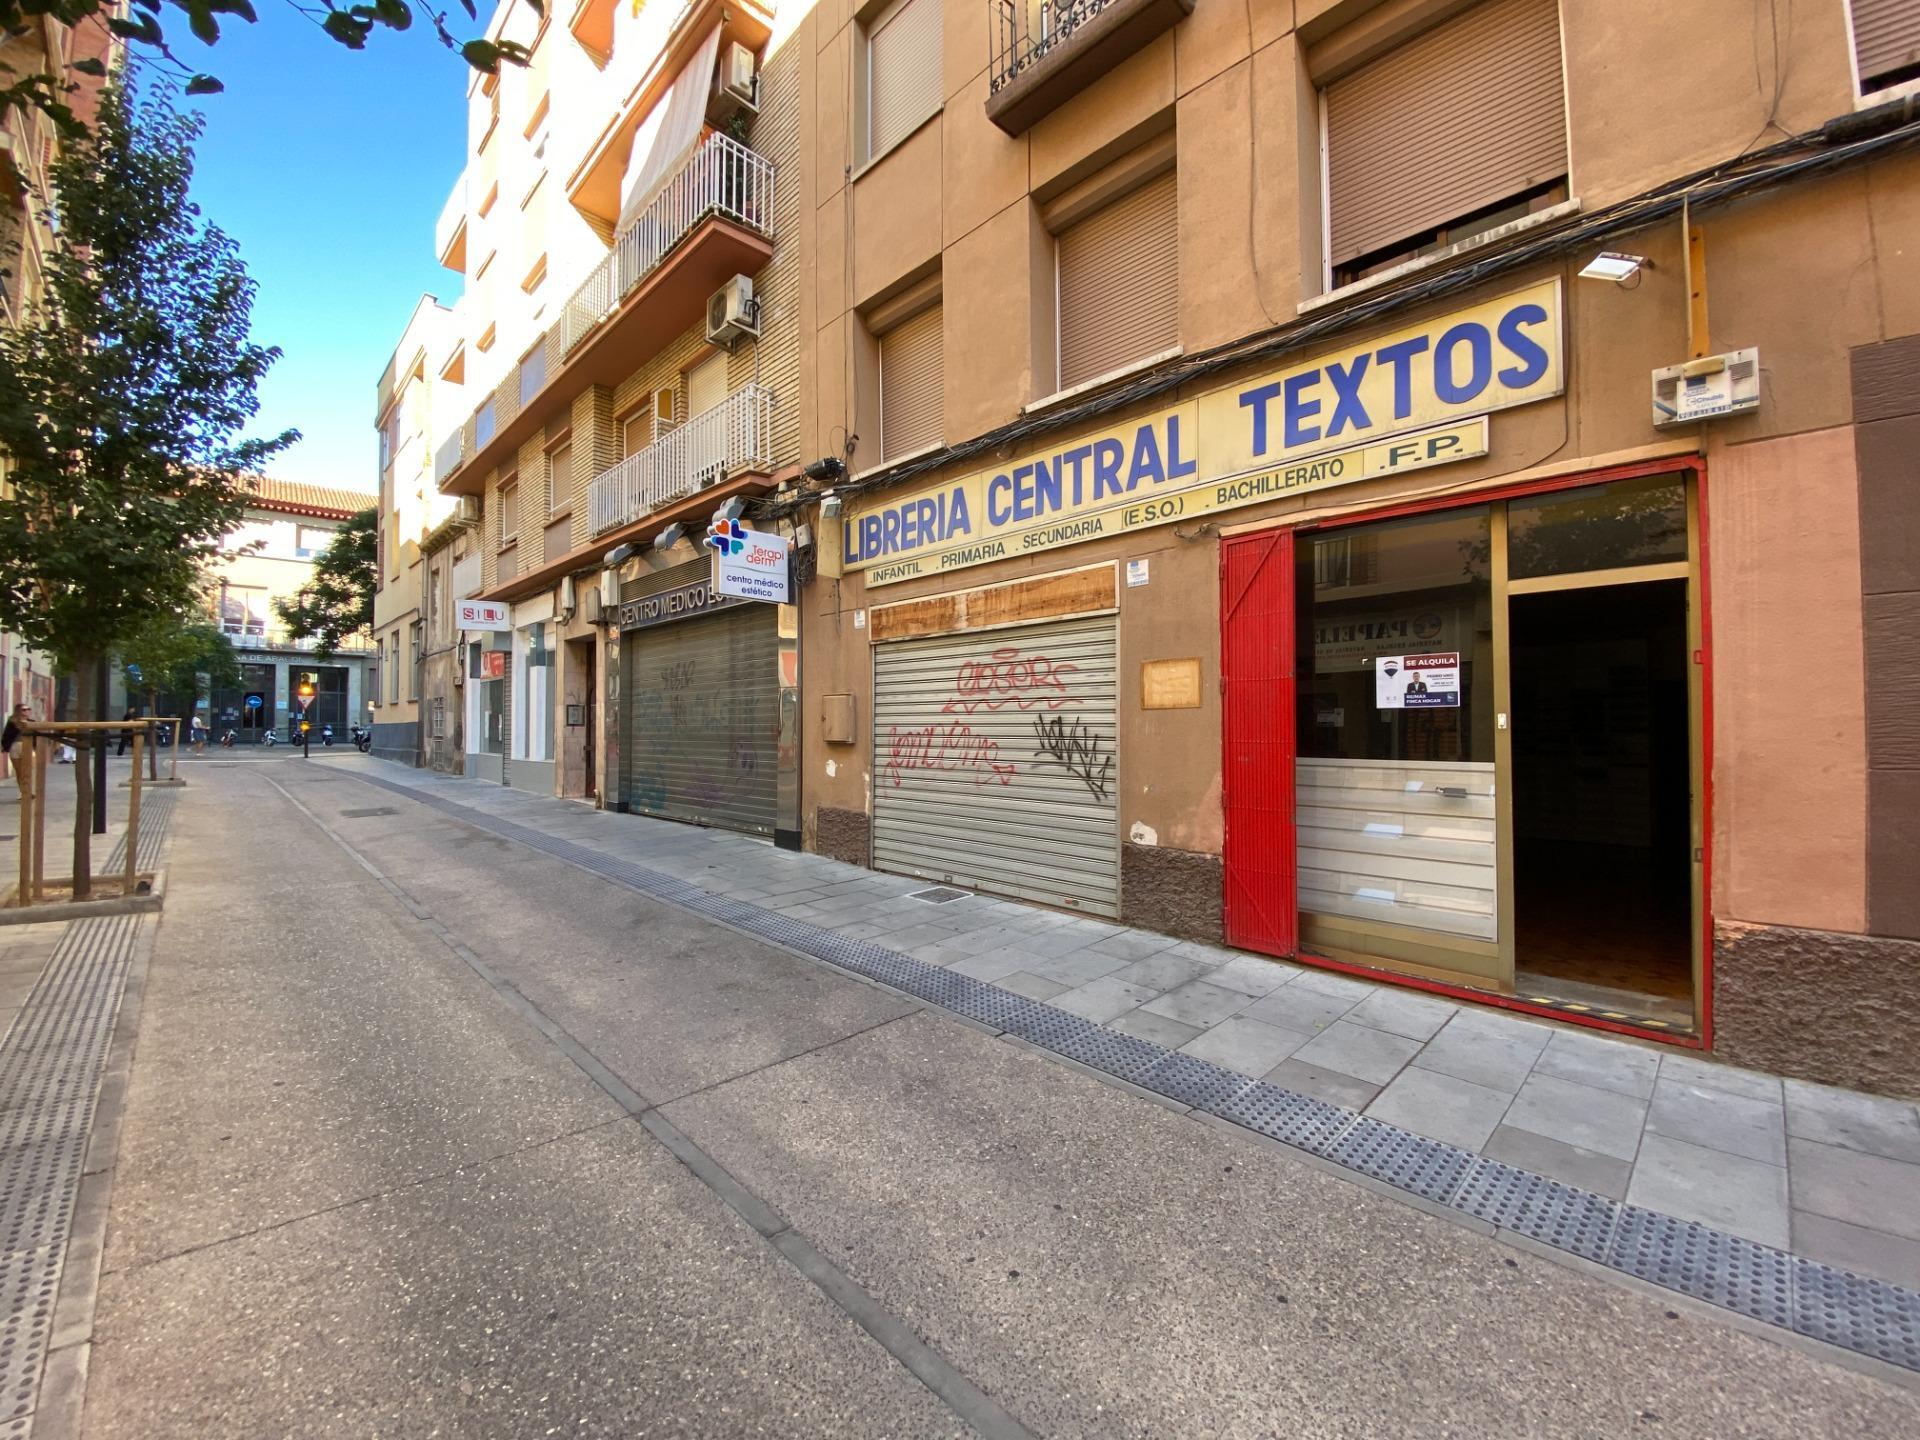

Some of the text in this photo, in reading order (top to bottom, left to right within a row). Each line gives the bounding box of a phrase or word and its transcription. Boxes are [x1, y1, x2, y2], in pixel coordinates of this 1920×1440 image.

[844, 304, 1549, 564] LIBRERIA CENTRAL TEXTOS
[1124, 497, 1184, 526] (E.S.O.)
[746, 552, 776, 567] derm
[753, 545, 785, 561] Terapi
[726, 574, 784, 590] centro médico
[741, 586, 772, 598] estético
[620, 599, 659, 625] CENTRO
[661, 587, 705, 616] MEDICO
[1406, 659, 1417, 667] SE
[1418, 657, 1455, 666] ALQUILA
